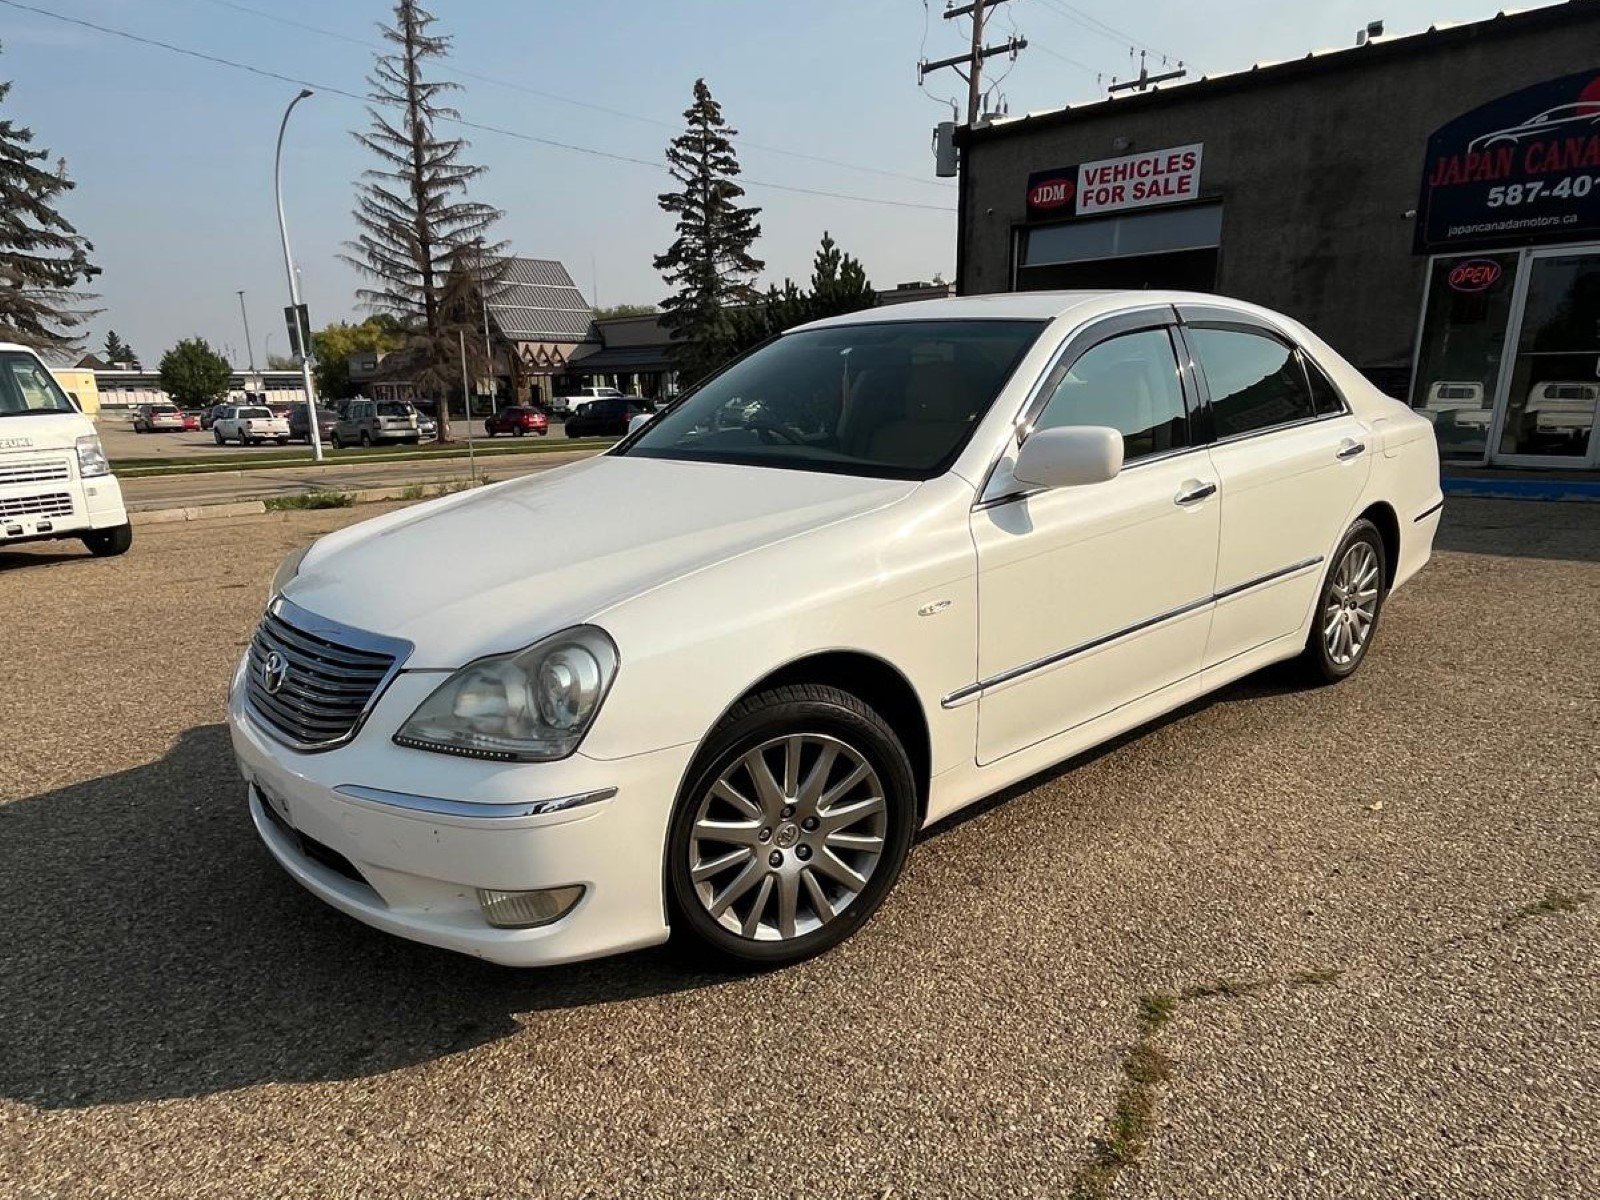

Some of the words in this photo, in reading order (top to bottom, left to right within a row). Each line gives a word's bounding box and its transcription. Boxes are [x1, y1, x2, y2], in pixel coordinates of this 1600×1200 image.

[1084, 152, 1196, 186] VEHICLES
[1429, 146, 1514, 186] JAPAN
[1033, 184, 1066, 204] JDM
[1083, 185, 1125, 207] FOR
[1132, 175, 1192, 200] SALE
[1448, 213, 1578, 237] japancanadamotors.ca
[1451, 265, 1498, 284] OPEN
